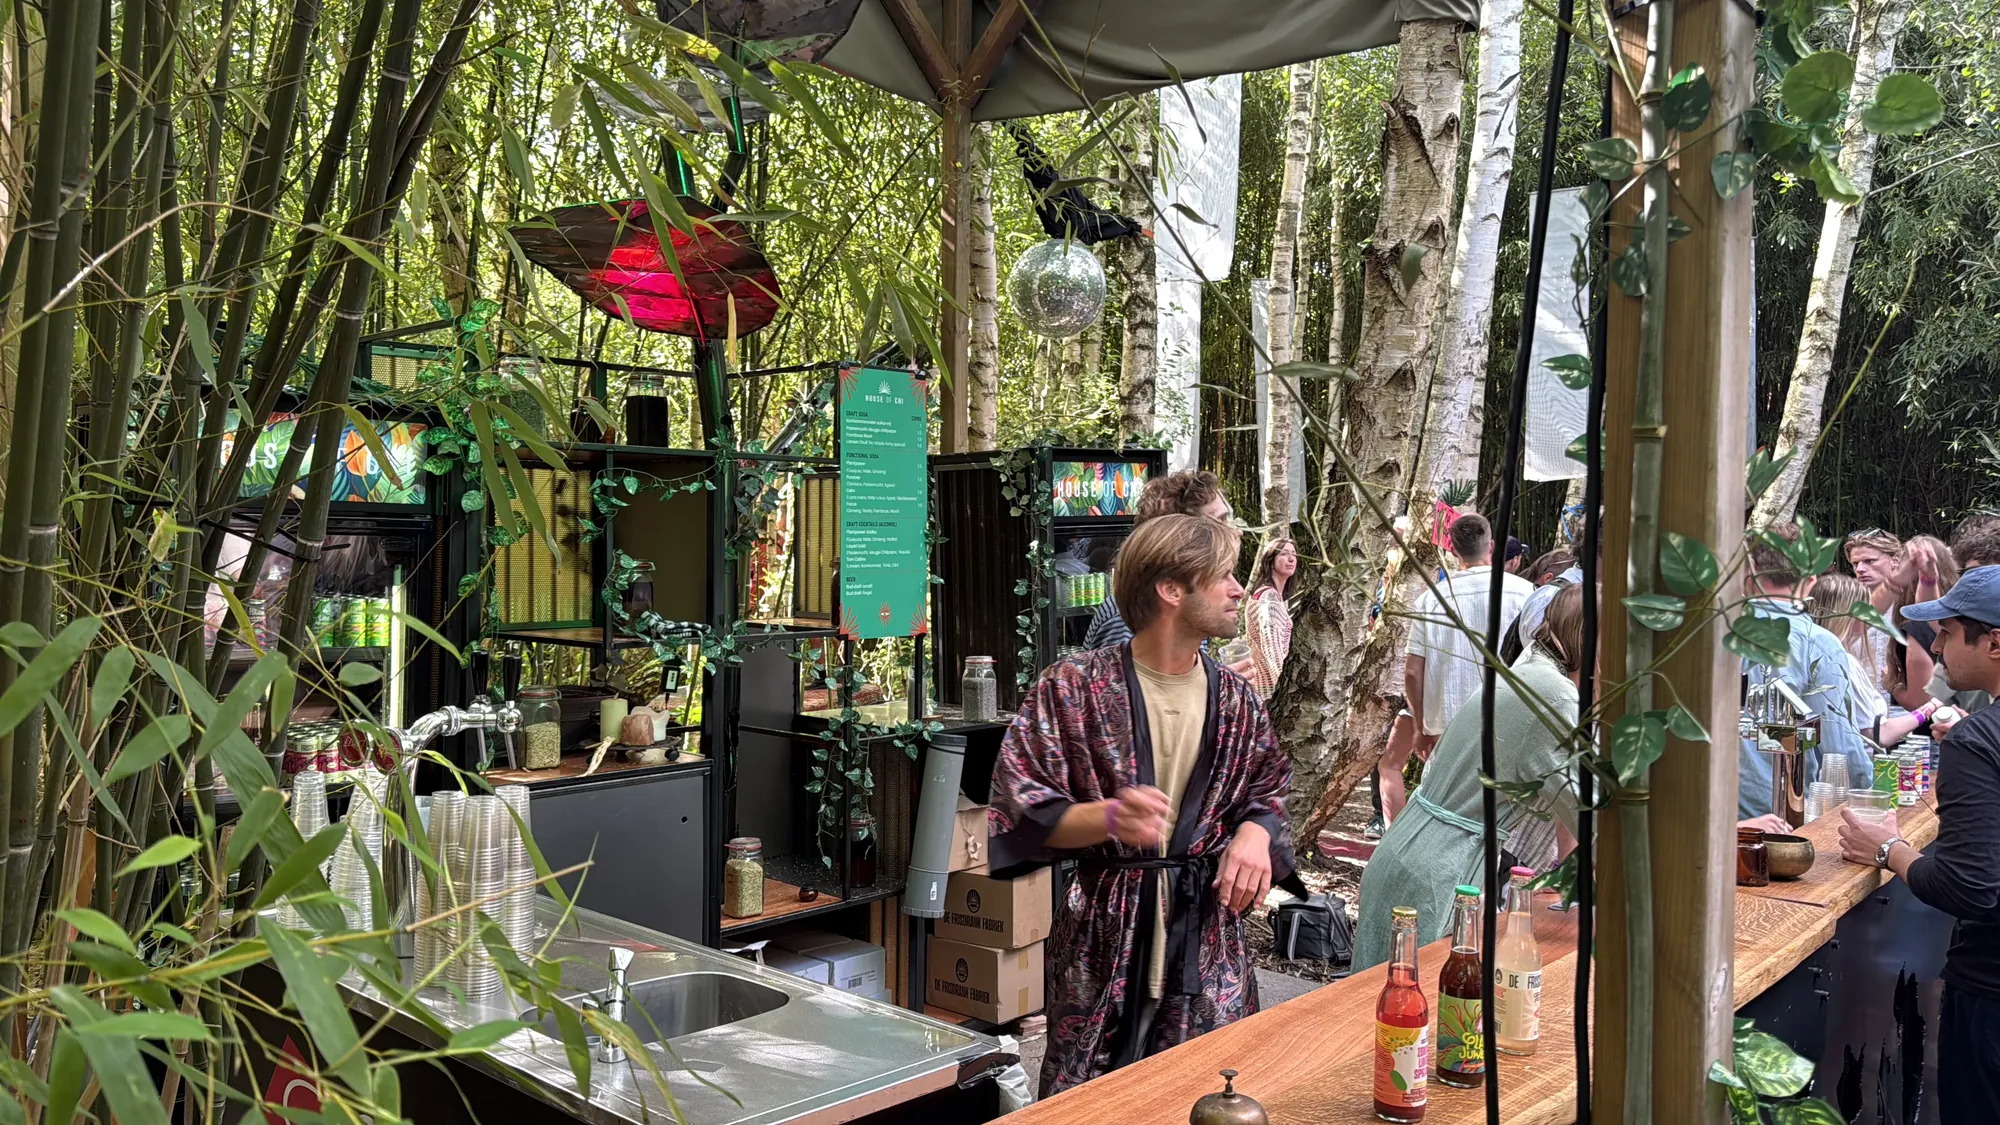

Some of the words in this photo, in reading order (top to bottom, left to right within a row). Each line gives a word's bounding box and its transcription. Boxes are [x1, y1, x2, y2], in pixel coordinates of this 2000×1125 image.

[865, 394, 883, 403] HOUSE
[1058, 481, 1096, 498] HOUSE
[944, 912, 950, 924] DE
[982, 918, 1004, 932] FABRIEK
[1509, 974, 1518, 988] DE
[935, 979, 941, 991] DE
[970, 988, 989, 1004] FABRIEK
